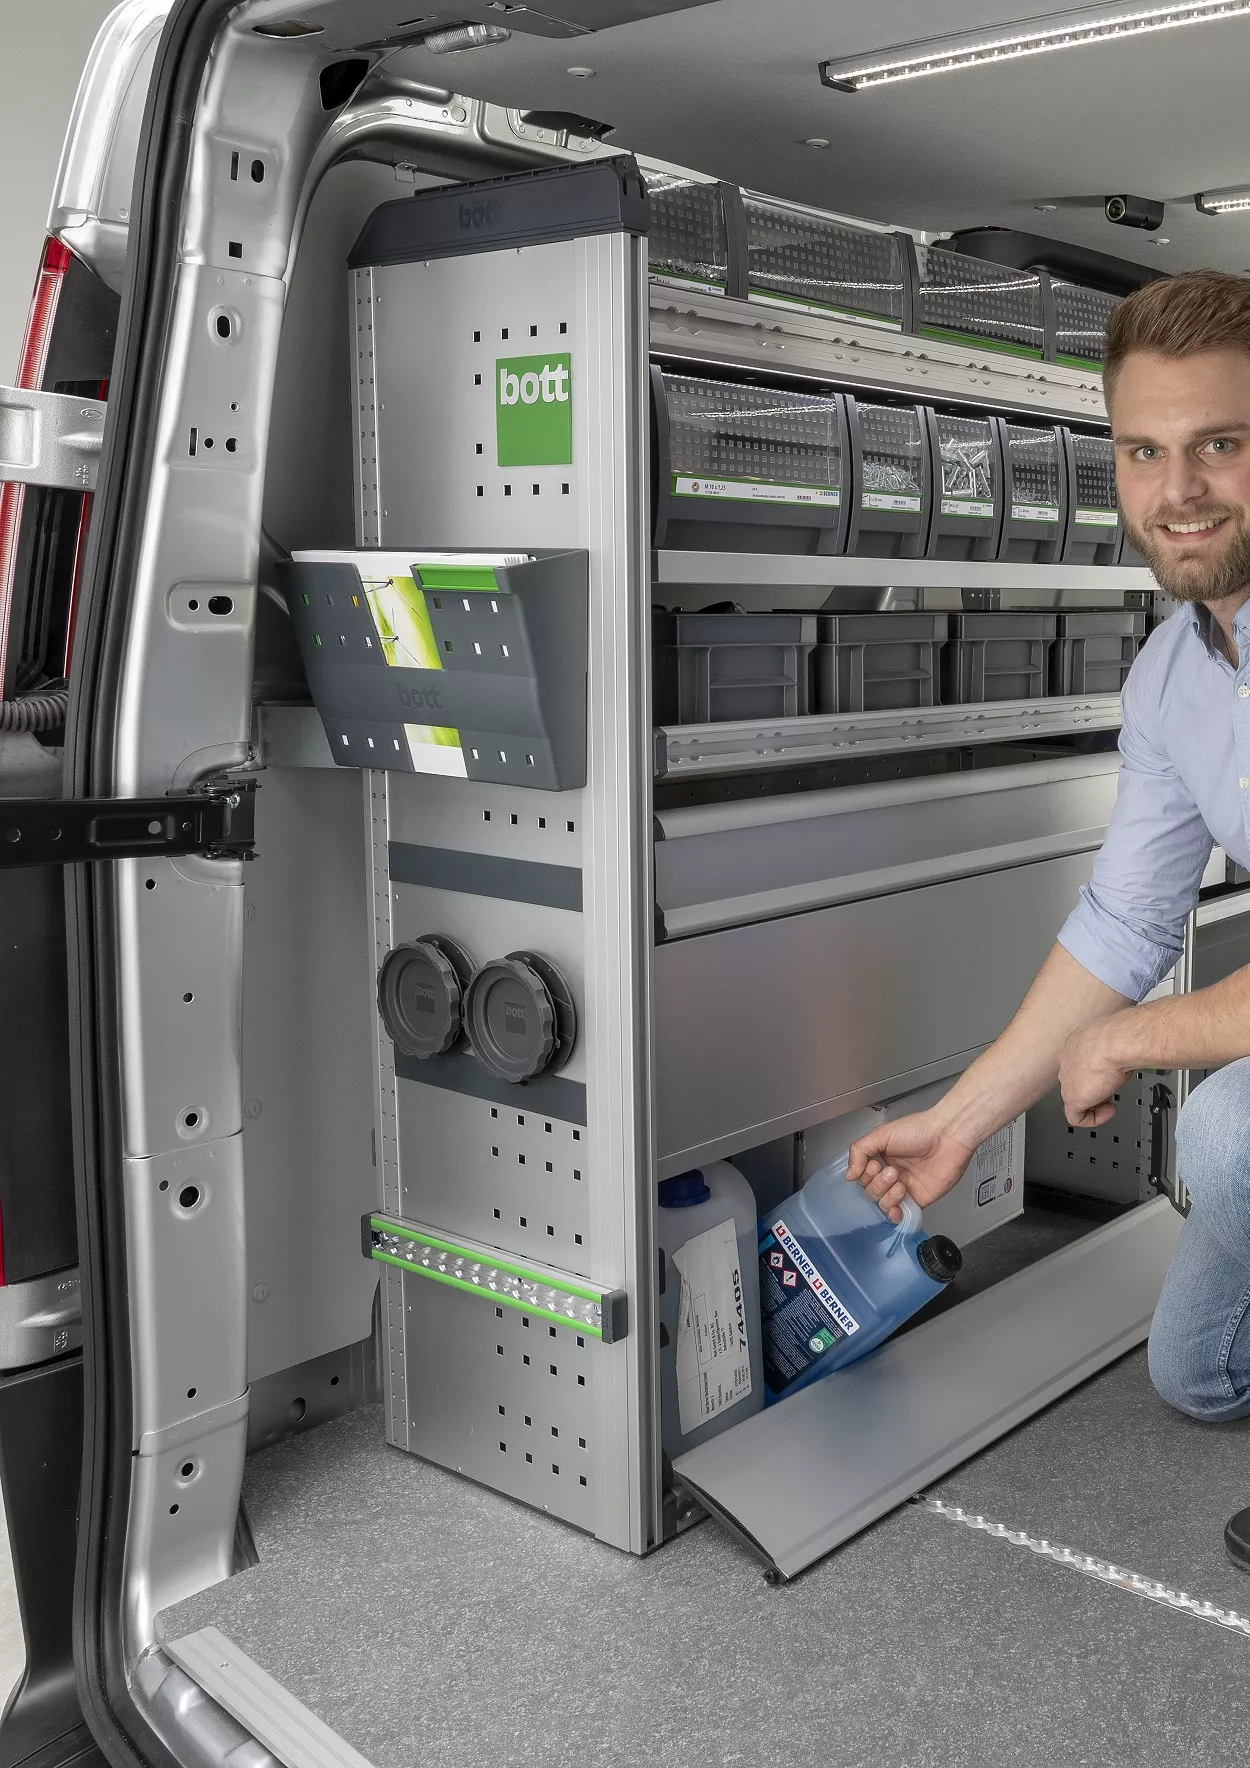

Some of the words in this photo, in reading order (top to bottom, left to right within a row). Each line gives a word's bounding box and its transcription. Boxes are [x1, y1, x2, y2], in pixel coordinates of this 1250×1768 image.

[459, 202, 504, 229] bott
[500, 363, 569, 405] bott
[396, 682, 444, 711] bott
[415, 983, 437, 999] bott
[504, 1004, 527, 1020] bott
[782, 1235, 815, 1279] BERNER
[819, 1288, 854, 1331] BERNER
[732, 1269, 747, 1353] 74405
